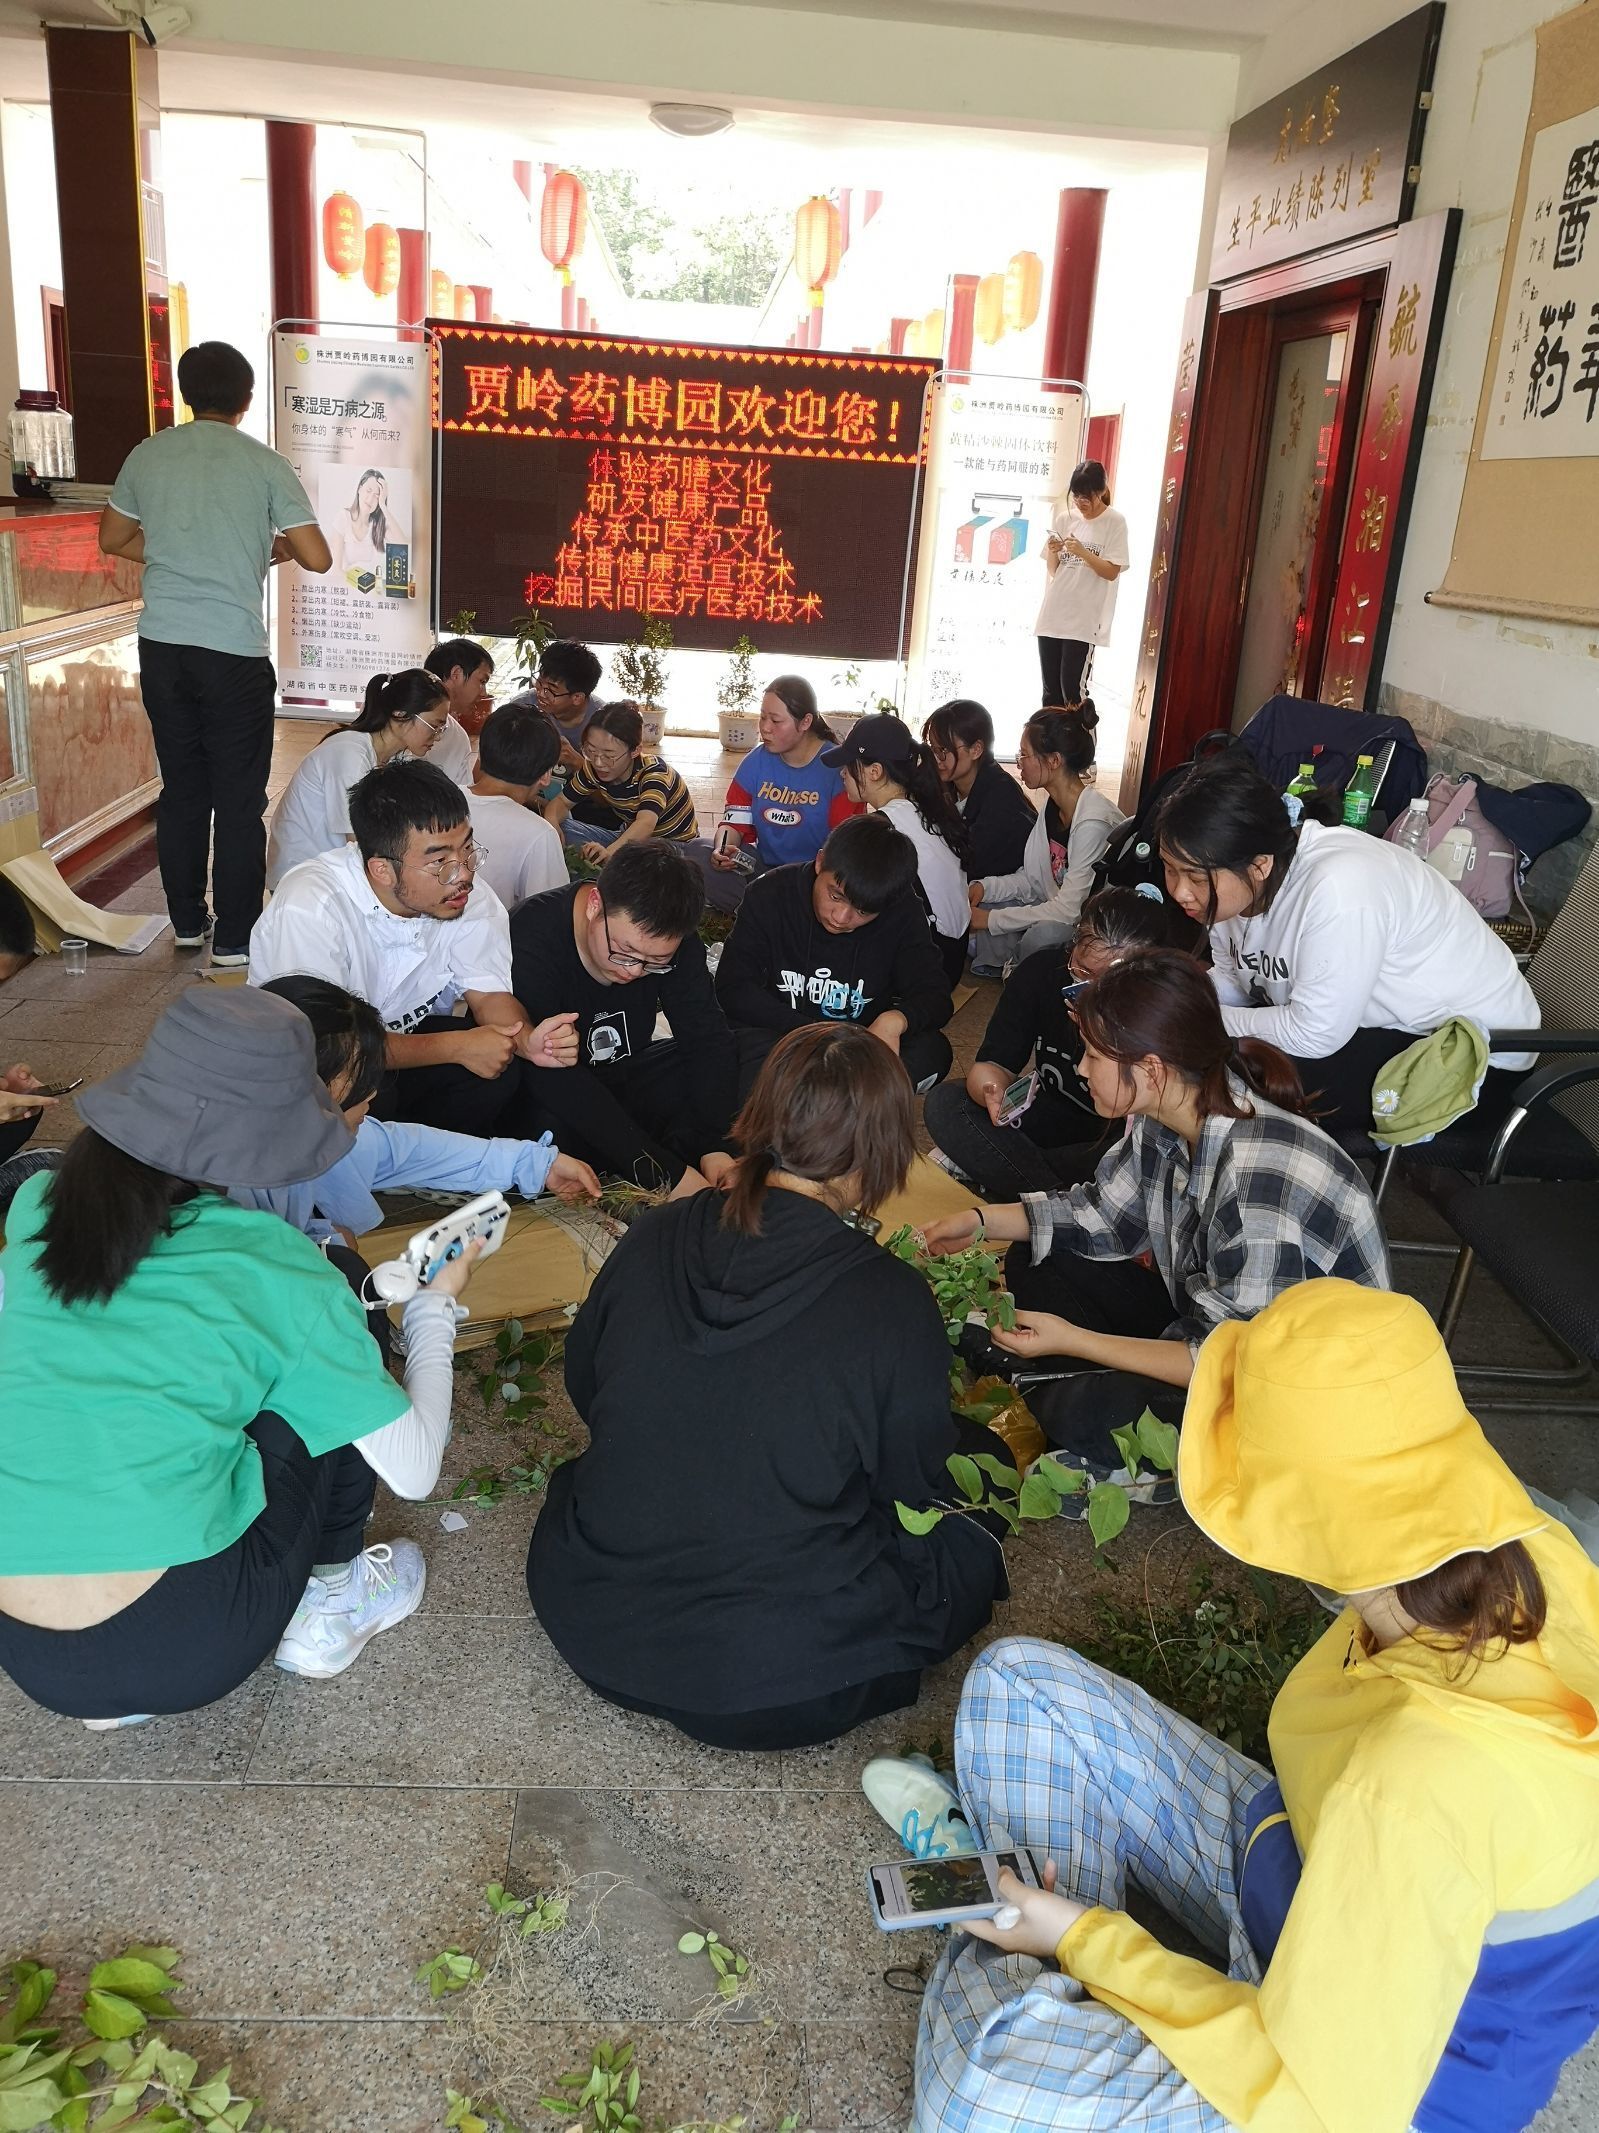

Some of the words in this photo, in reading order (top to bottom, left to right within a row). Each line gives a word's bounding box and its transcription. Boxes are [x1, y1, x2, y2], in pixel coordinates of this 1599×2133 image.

[464, 364, 899, 444] 贾岭药博园欢迎您!
[589, 448, 772, 493] 体验药膳文化
[587, 481, 768, 527] 研发健康产品
[571, 511, 784, 559] 传承中医药文化
[555, 541, 797, 588] 传播健康适宜技术
[524, 572, 824, 624] 挖掘民间医疗医药技术
